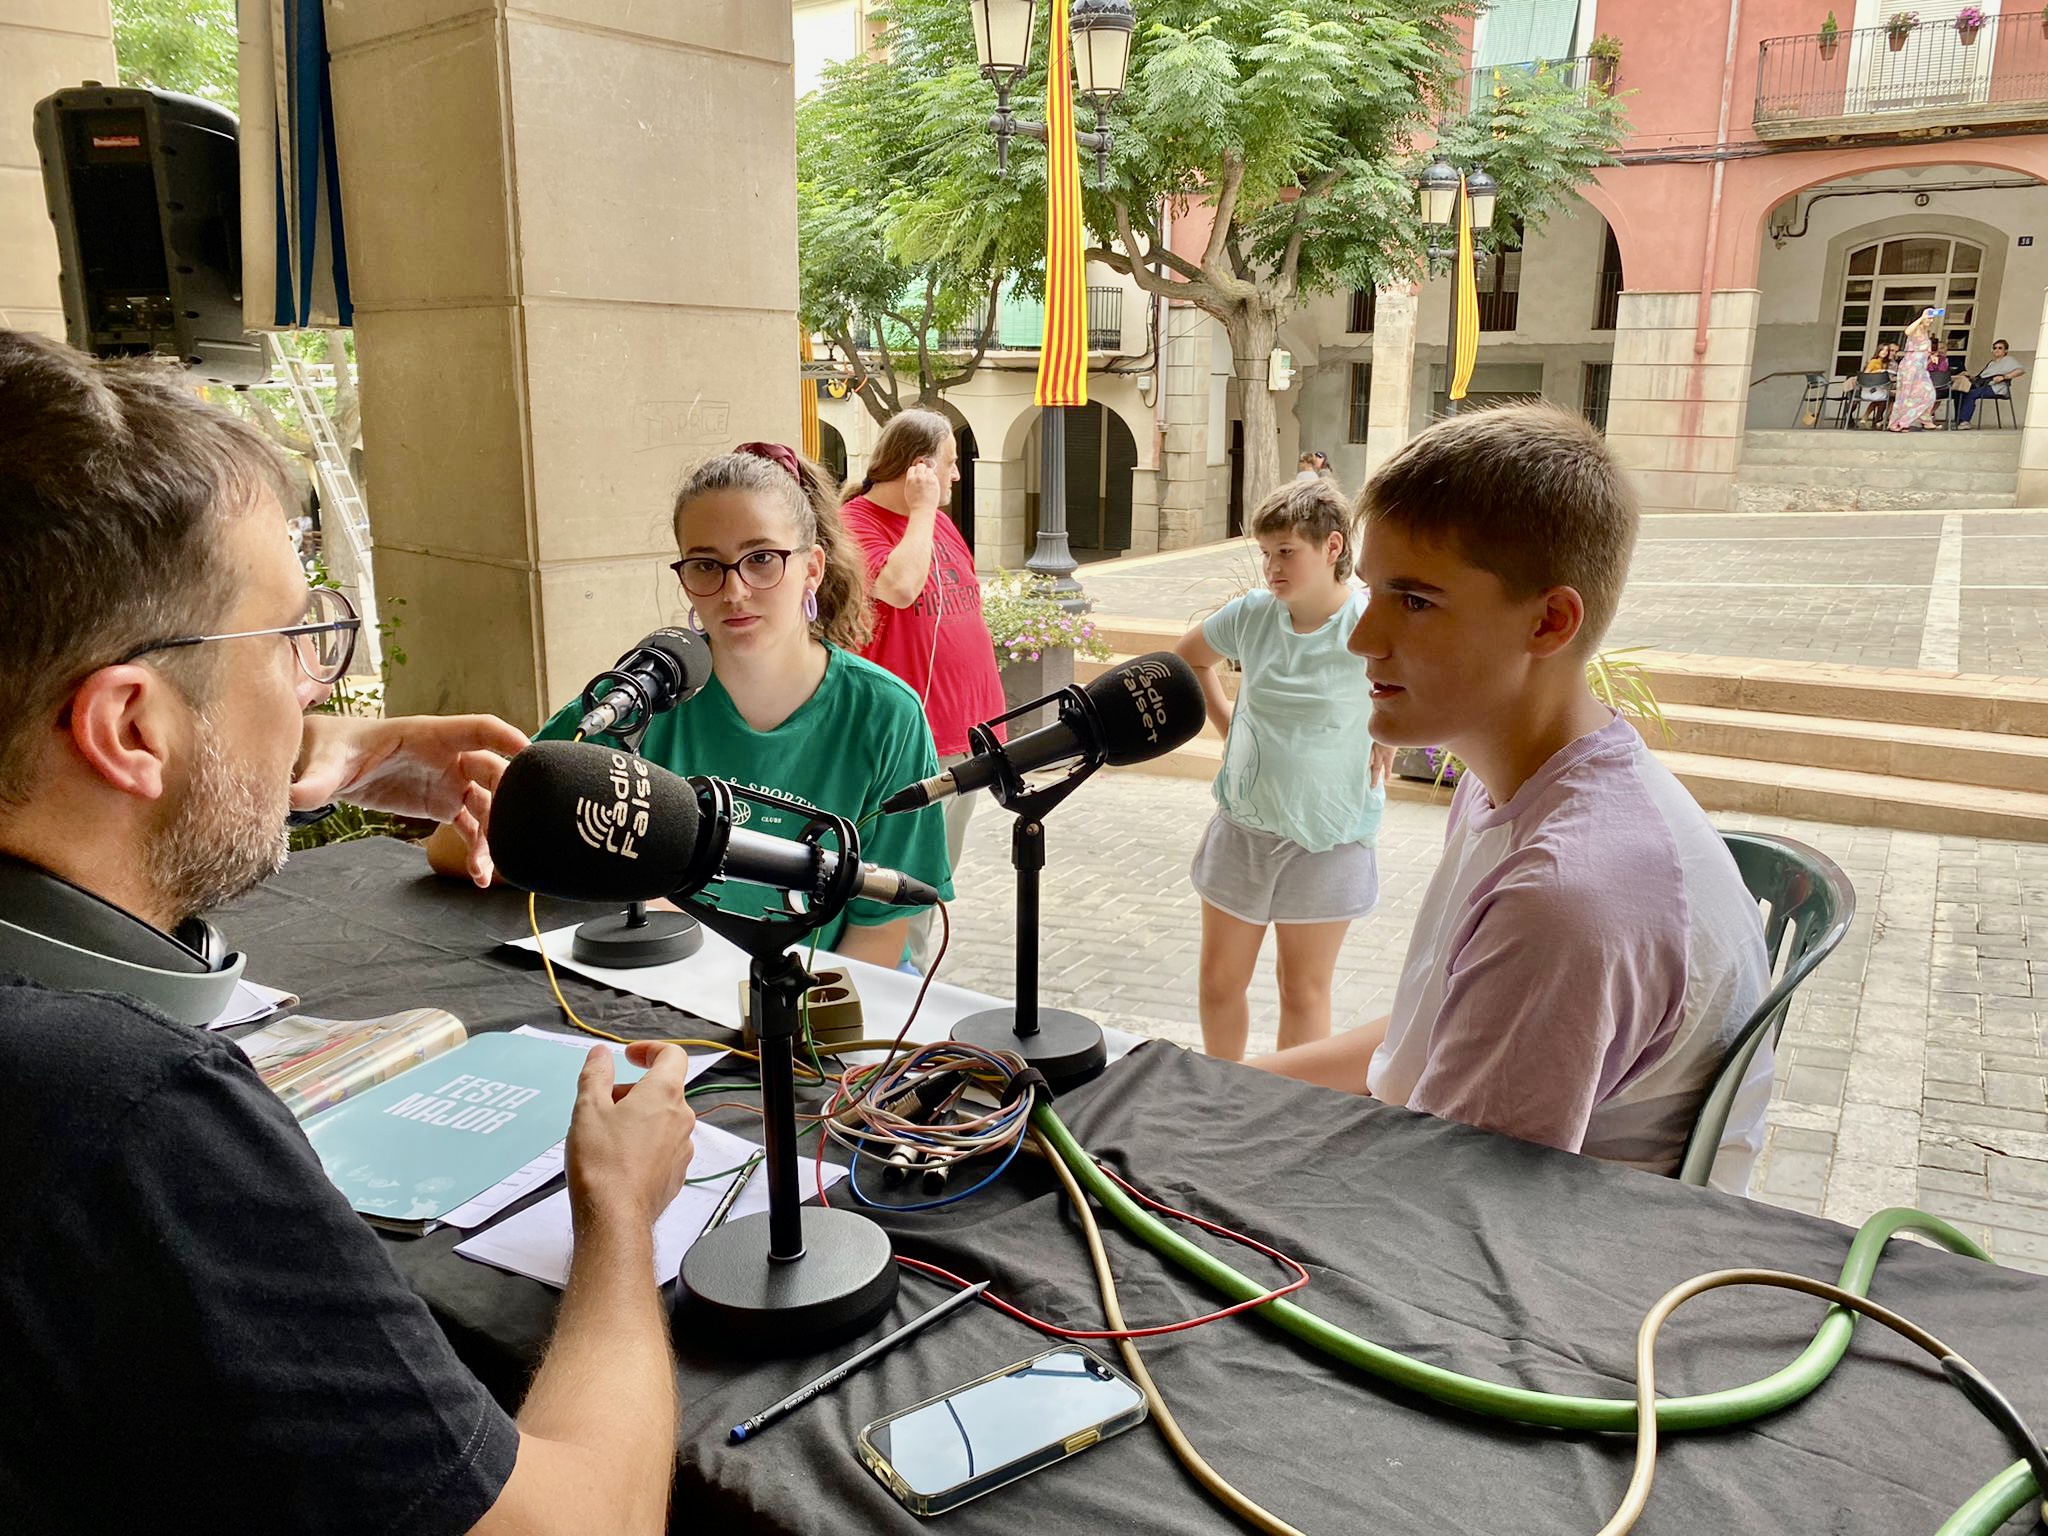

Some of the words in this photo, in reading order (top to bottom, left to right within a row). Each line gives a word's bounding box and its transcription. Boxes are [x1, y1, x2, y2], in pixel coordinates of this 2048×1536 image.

[621, 759, 651, 859] False
[433, 1073, 542, 1110] FESTA
[383, 1092, 518, 1135] MAJOR
